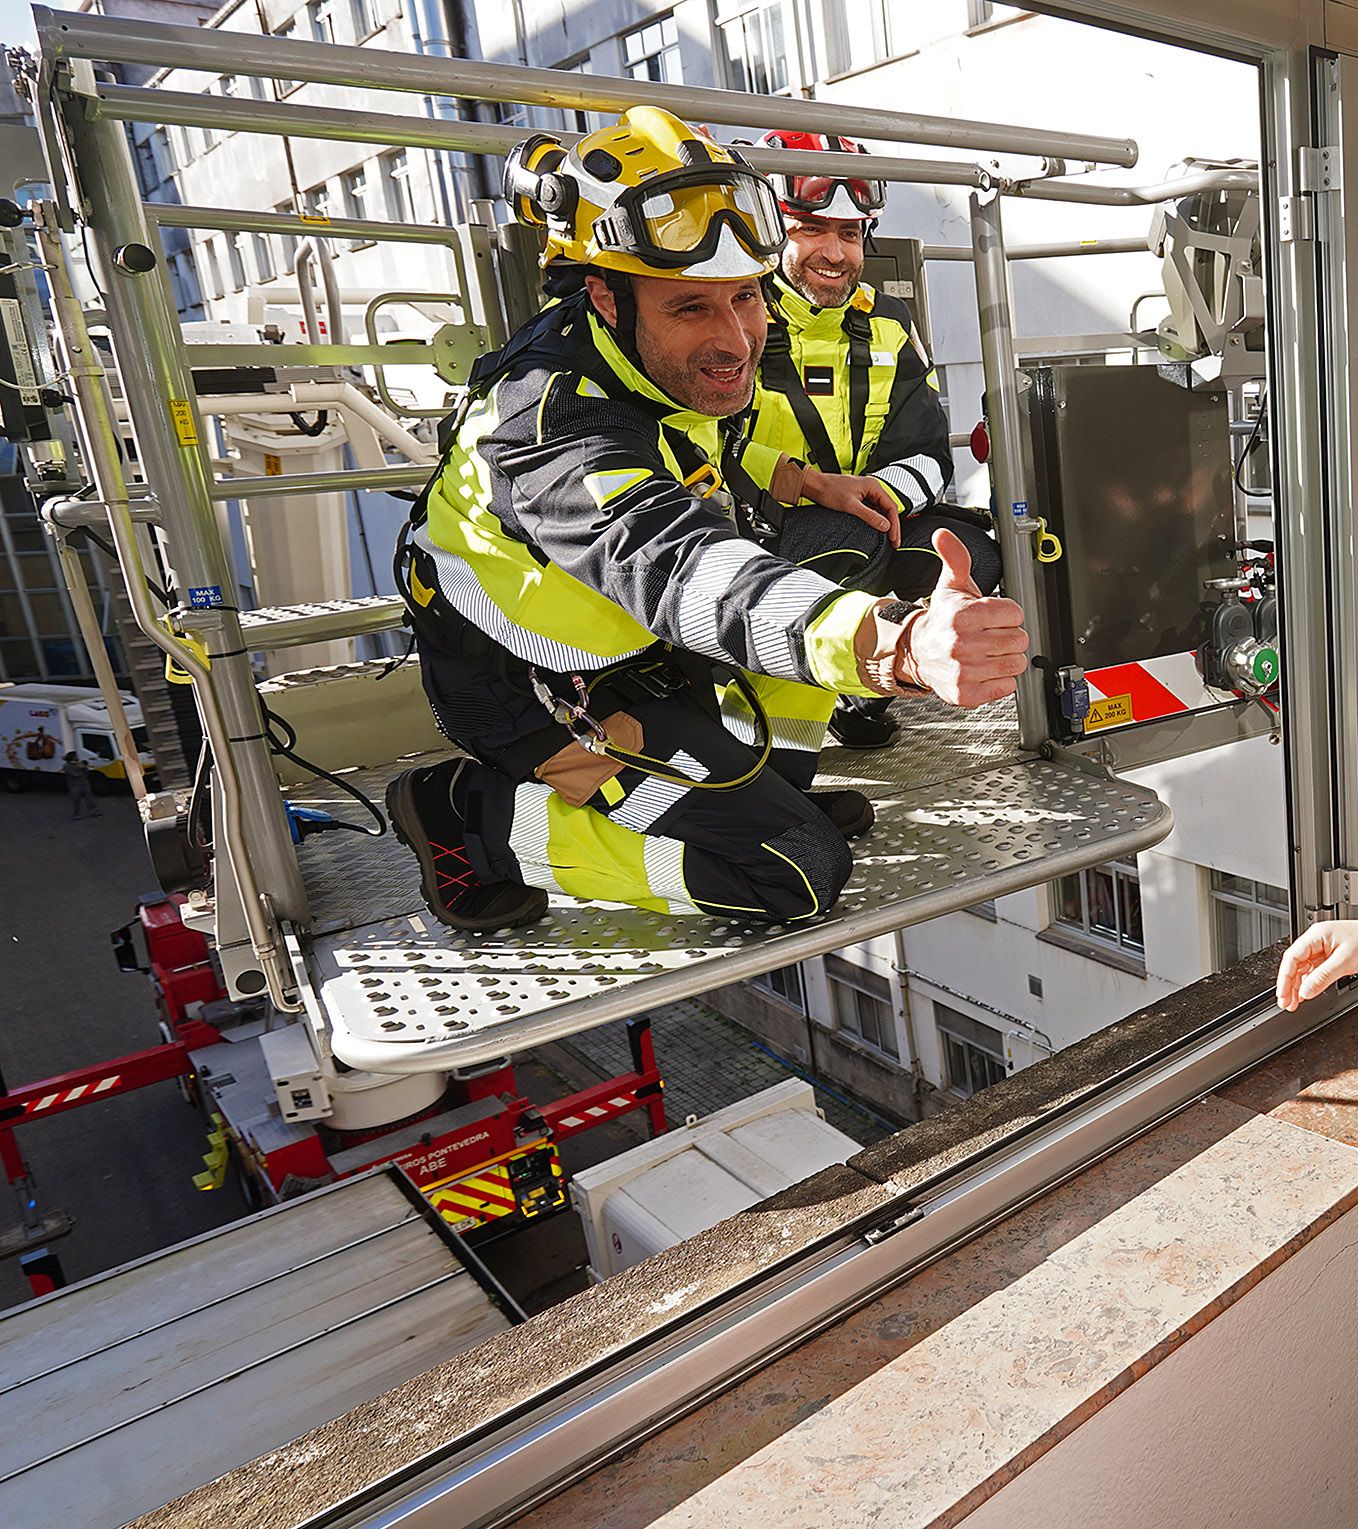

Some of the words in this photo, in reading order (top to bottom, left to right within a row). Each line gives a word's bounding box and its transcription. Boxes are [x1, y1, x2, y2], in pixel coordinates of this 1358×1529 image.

[195, 589, 216, 597] MAX
[1107, 703, 1122, 711] MAX
[1104, 711, 1116, 719] 200
[1116, 708, 1126, 716] KG
[427, 1131, 490, 1161] PONTEVEDRA
[419, 1157, 448, 1176] ABE
